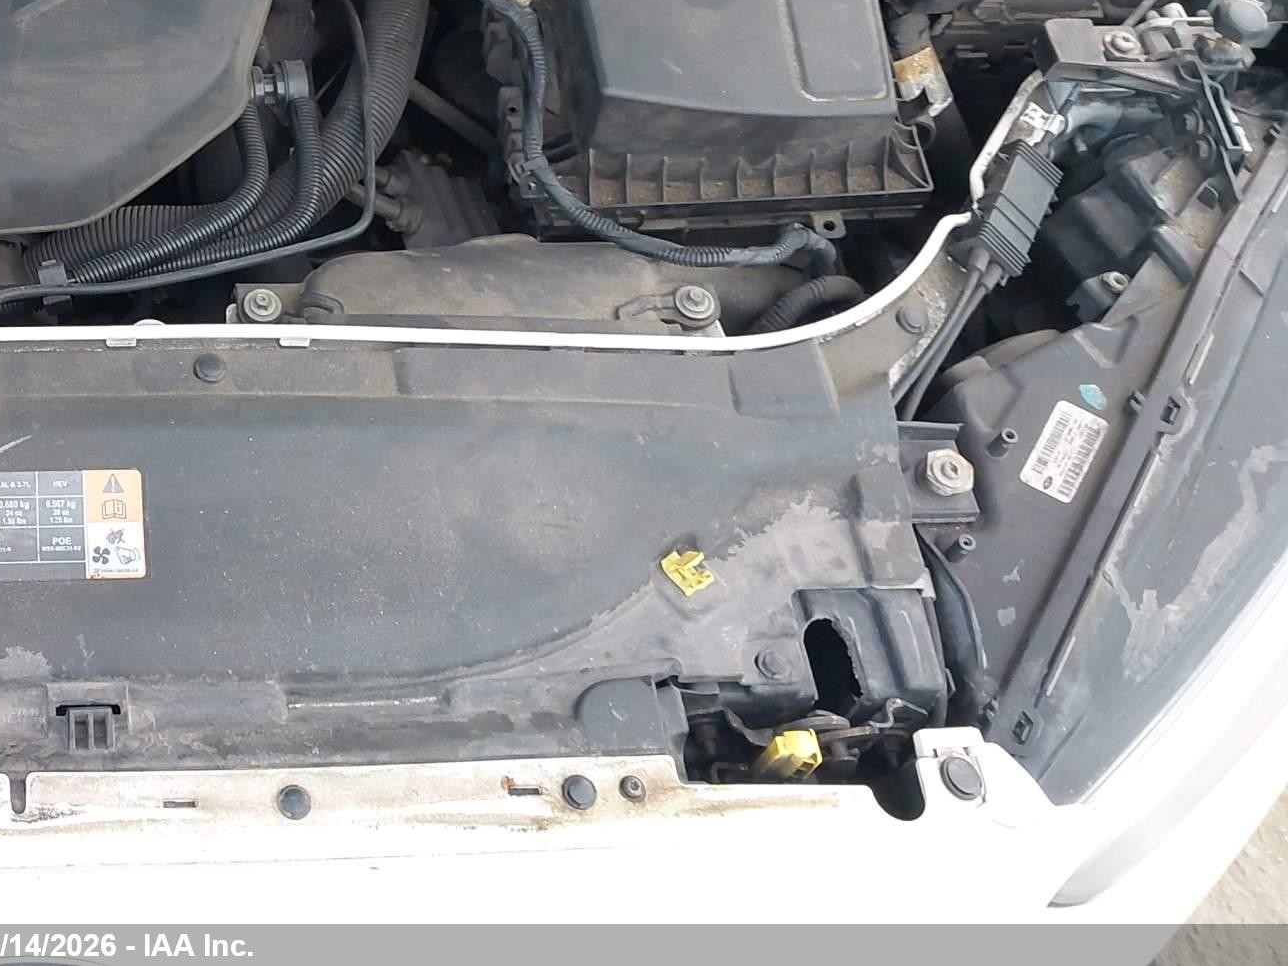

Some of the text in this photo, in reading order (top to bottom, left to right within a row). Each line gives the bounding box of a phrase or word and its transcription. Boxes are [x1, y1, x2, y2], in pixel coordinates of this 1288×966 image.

[20, 500, 30, 510] kg
[66, 500, 76, 510] kg
[52, 537, 72, 546] POE
